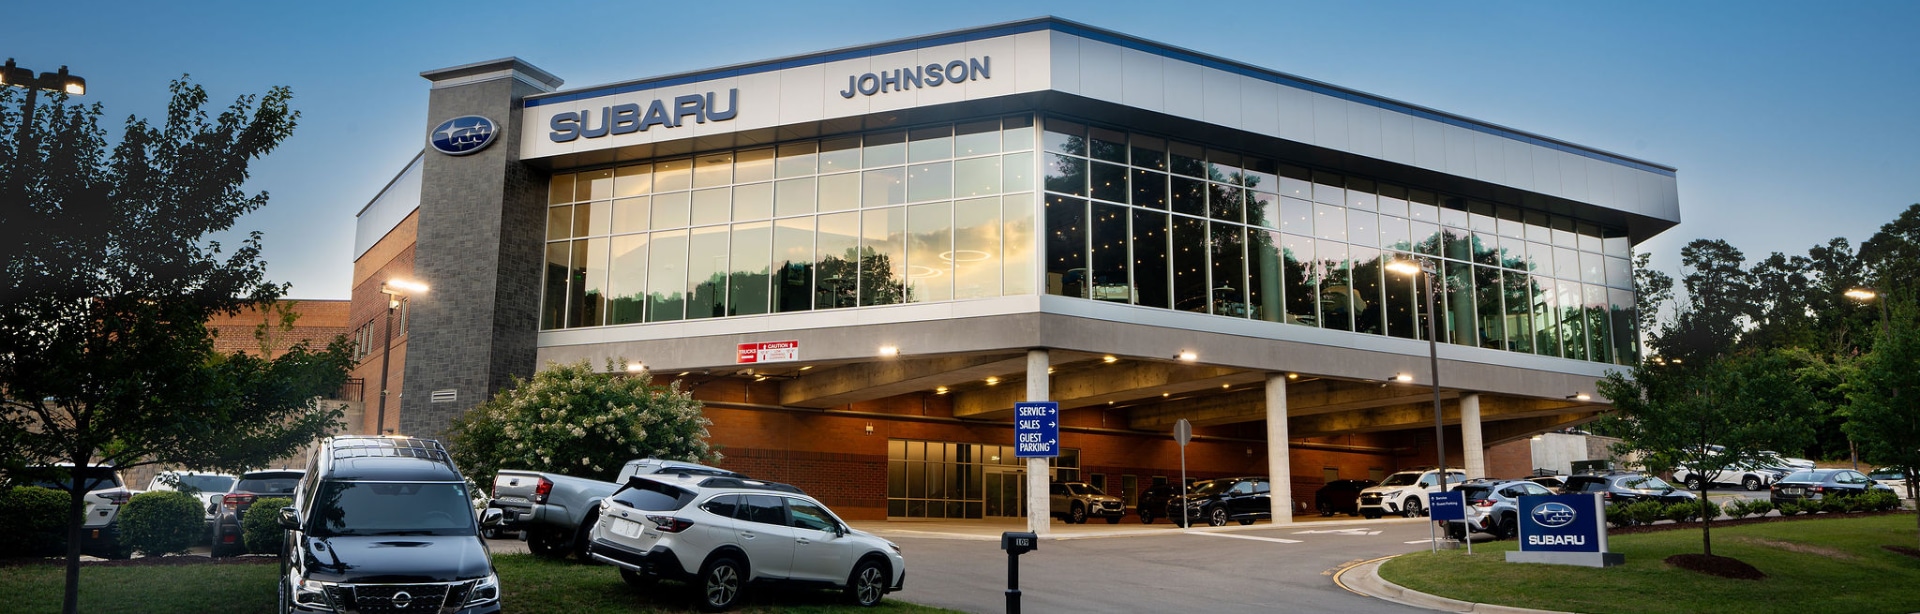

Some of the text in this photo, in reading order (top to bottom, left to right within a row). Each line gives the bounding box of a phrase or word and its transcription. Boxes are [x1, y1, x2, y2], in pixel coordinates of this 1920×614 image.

[840, 56, 990, 98] JOHNSON
[549, 88, 738, 142] SUBARU
[1019, 407, 1046, 416] SERVICE
[1019, 420, 1040, 429] SALES
[1019, 433, 1042, 442] GUEST
[1020, 442, 1050, 452] PARKING
[1528, 535, 1585, 545] SUBARU
